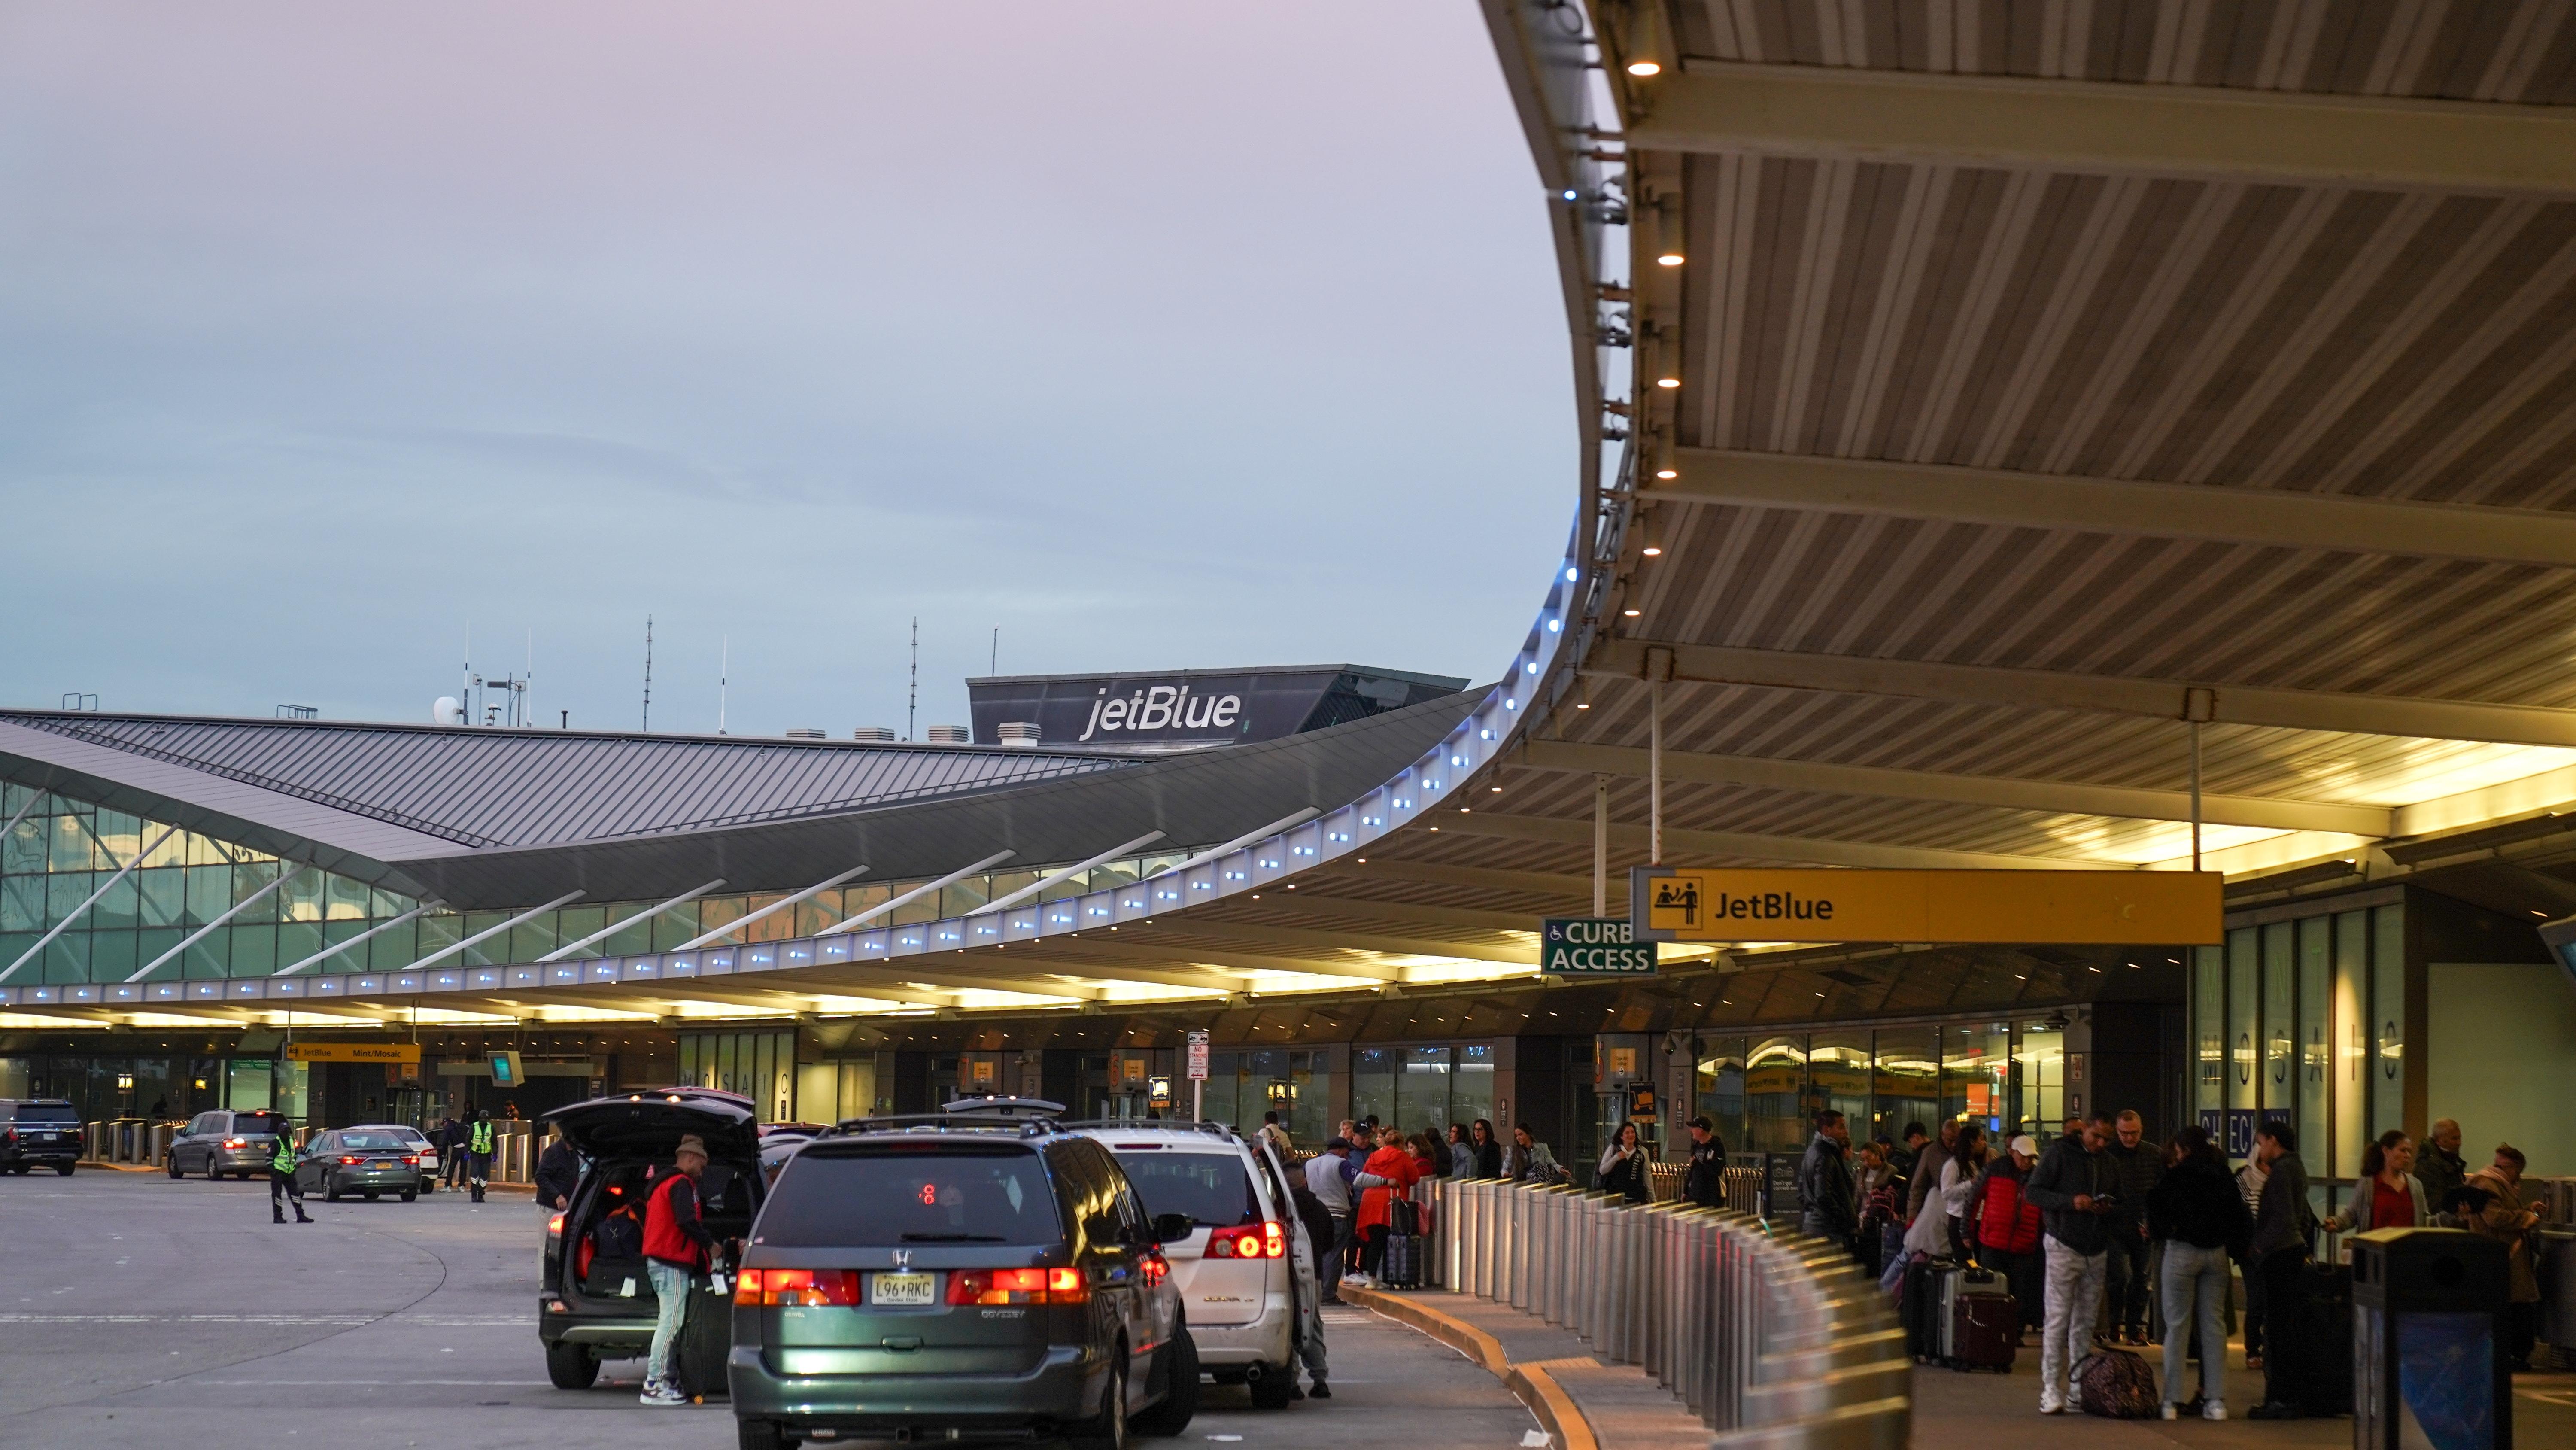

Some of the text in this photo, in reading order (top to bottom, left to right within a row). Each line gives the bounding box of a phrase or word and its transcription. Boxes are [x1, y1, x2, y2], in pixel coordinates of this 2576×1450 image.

[1078, 685, 1241, 742] jetBlue
[1716, 892, 1833, 920] JetBlue
[1565, 922, 1631, 944] CURB
[1550, 948, 1649, 970] ACCESS
[303, 1049, 332, 1057] JetBlue
[961, 1058, 969, 1086] 7
[1111, 1054, 1120, 1087] 6
[981, 1309, 1026, 1318] ODYSSEY
